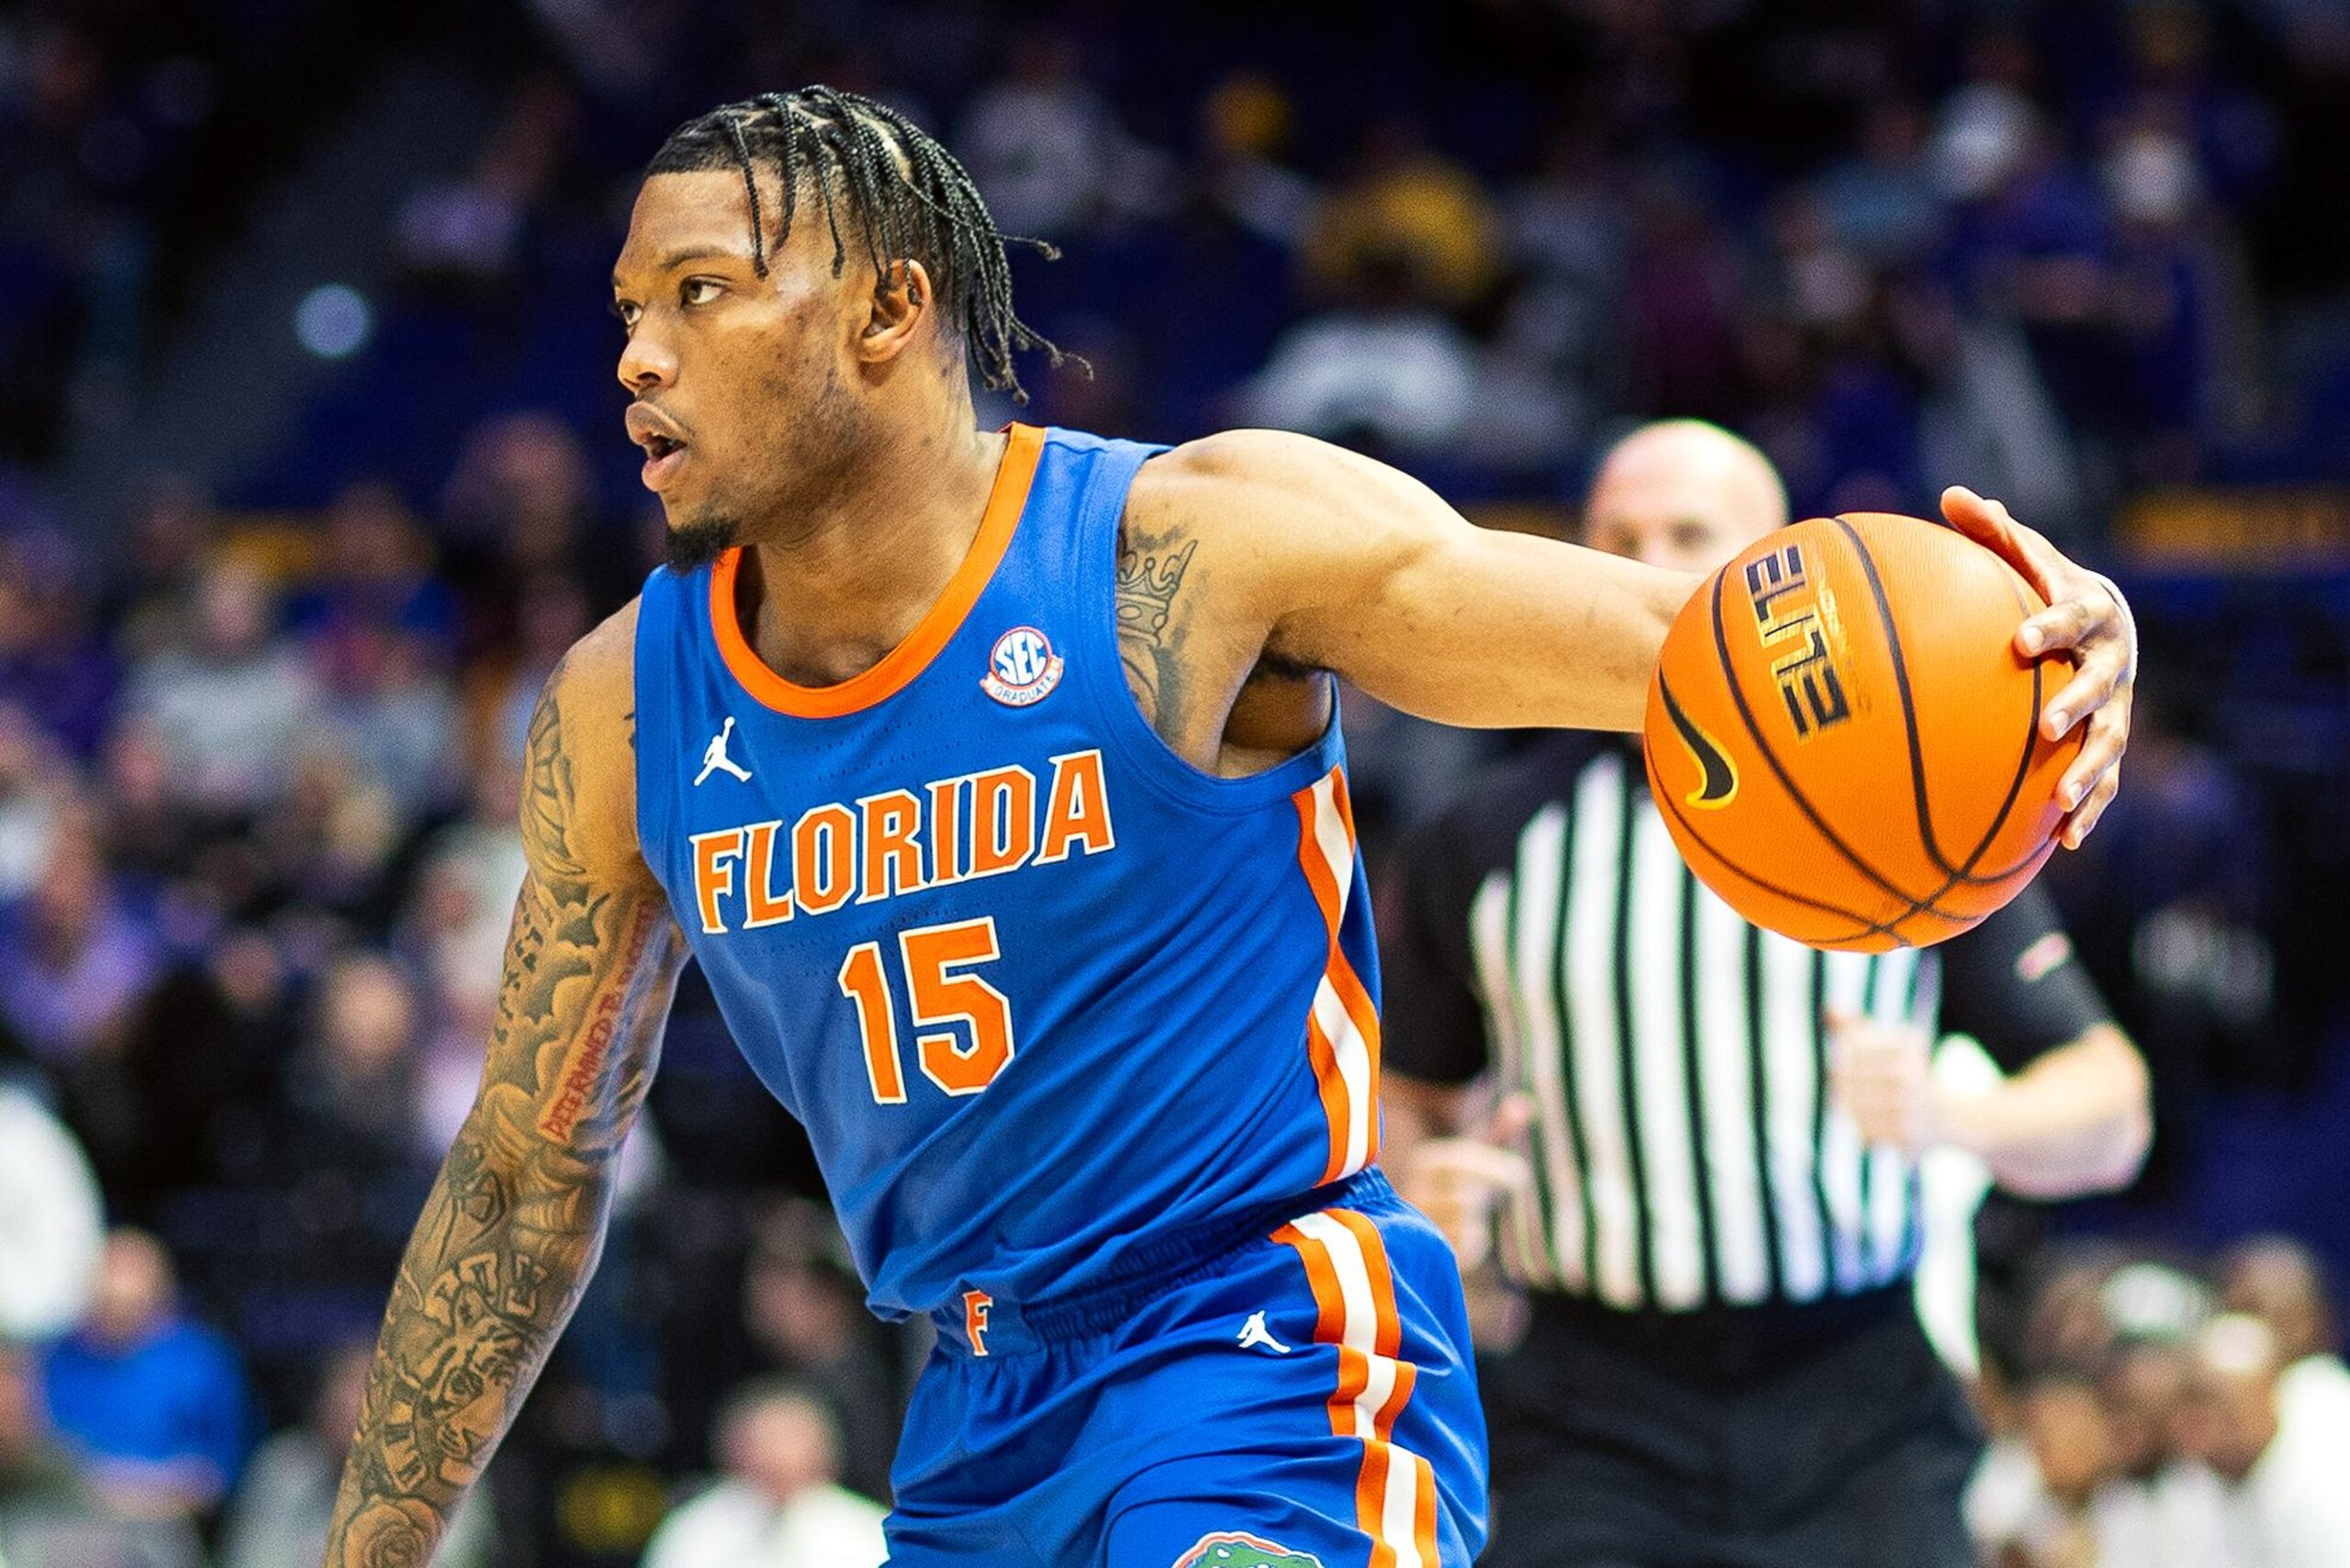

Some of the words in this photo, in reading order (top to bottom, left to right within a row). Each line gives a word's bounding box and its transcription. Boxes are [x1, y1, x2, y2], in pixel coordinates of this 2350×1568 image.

[994, 631, 1047, 685] SEC
[994, 674, 1056, 704] GRADUATE
[1744, 543, 1852, 742] ELITE
[688, 748, 1115, 935] FLORIDA
[837, 916, 1015, 1105] 15
[962, 1289, 994, 1357] F
